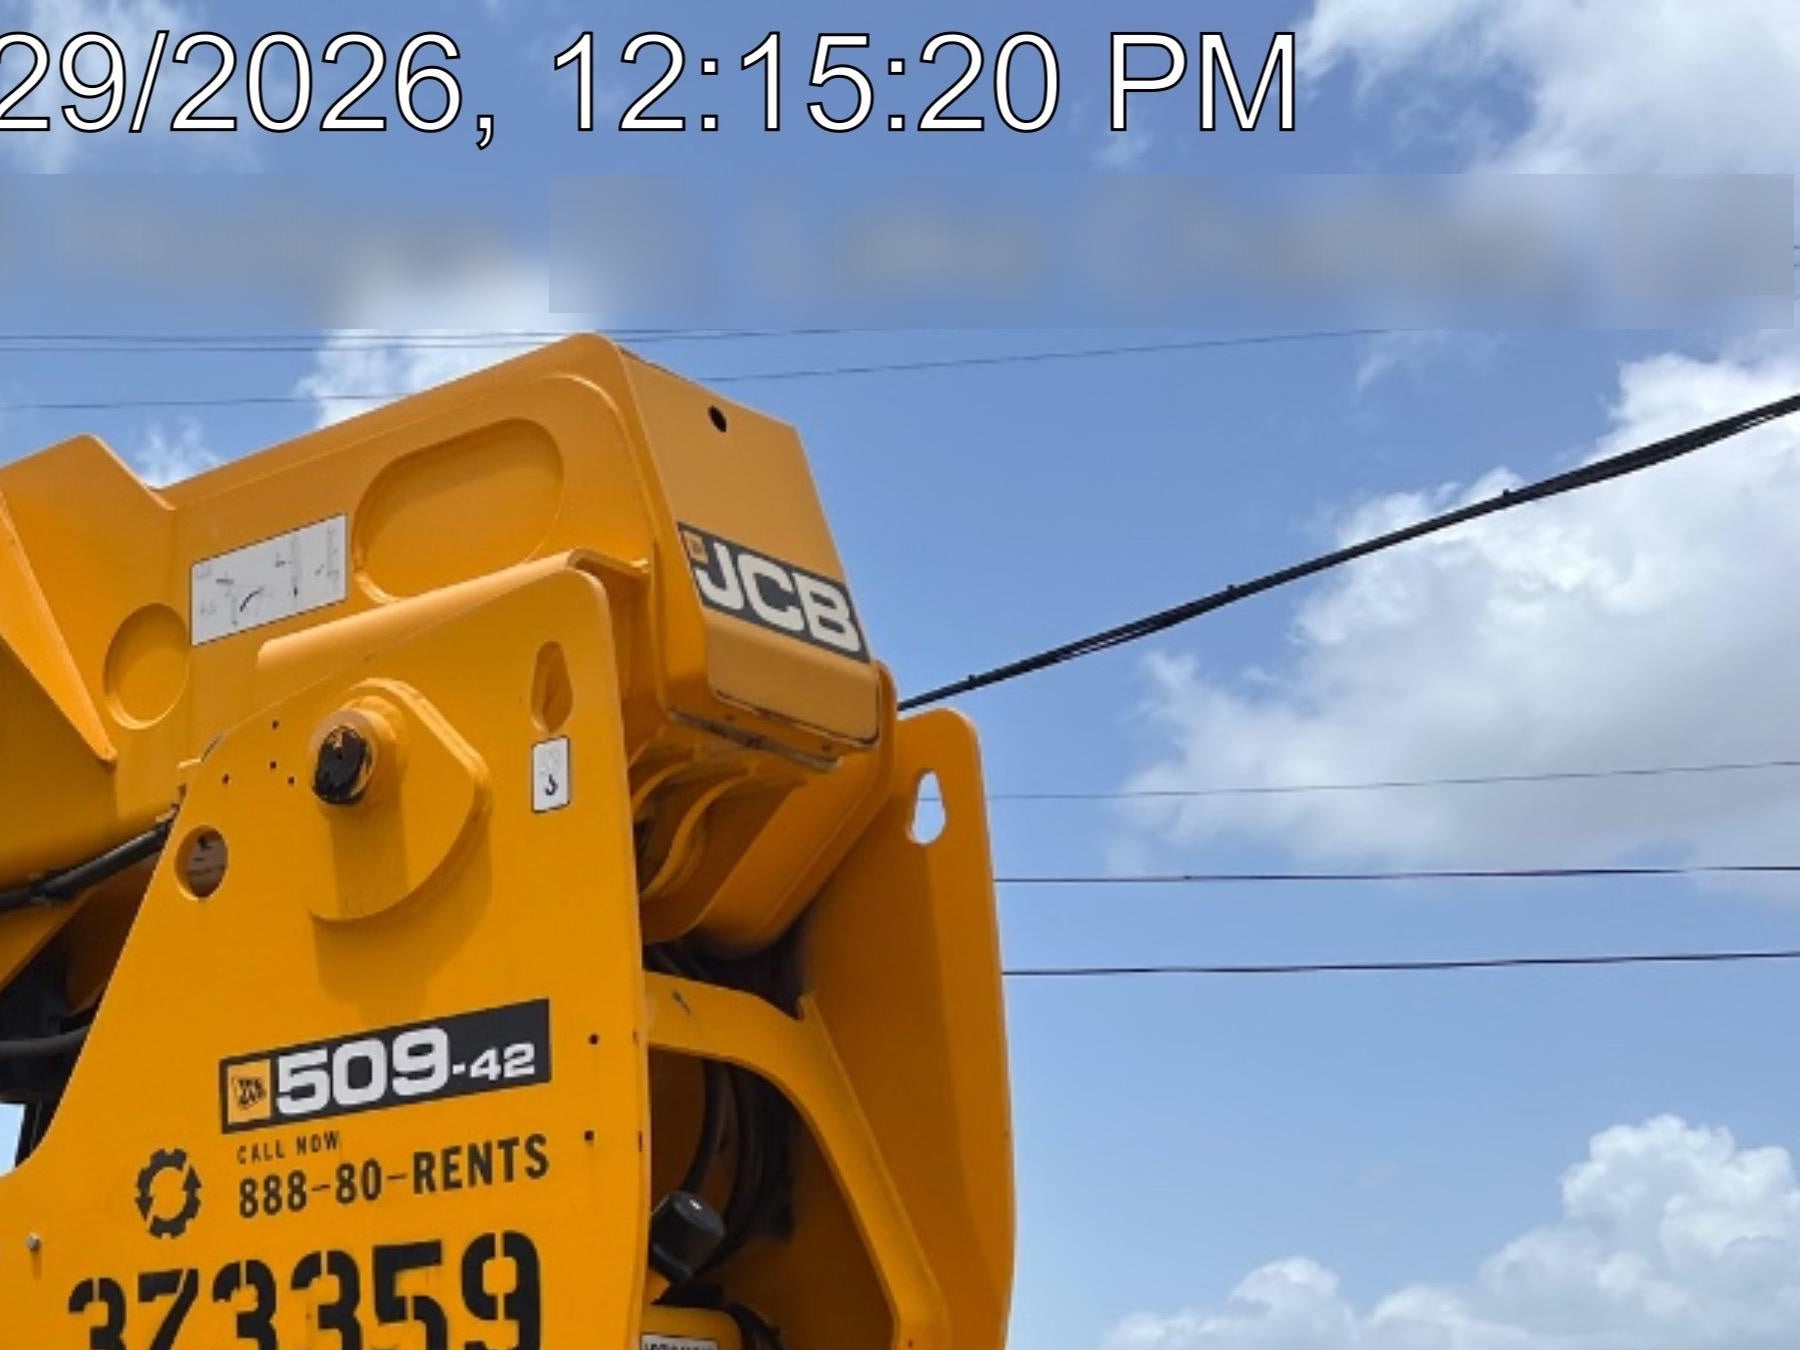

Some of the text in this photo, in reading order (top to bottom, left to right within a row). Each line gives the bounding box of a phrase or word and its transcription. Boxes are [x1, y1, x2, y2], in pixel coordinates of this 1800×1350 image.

[694, 541, 861, 652] JCB
[277, 1027, 536, 1115] 509-42
[237, 1131, 340, 1164] CALL NOW
[239, 1134, 549, 1218] 888-80-RENTS
